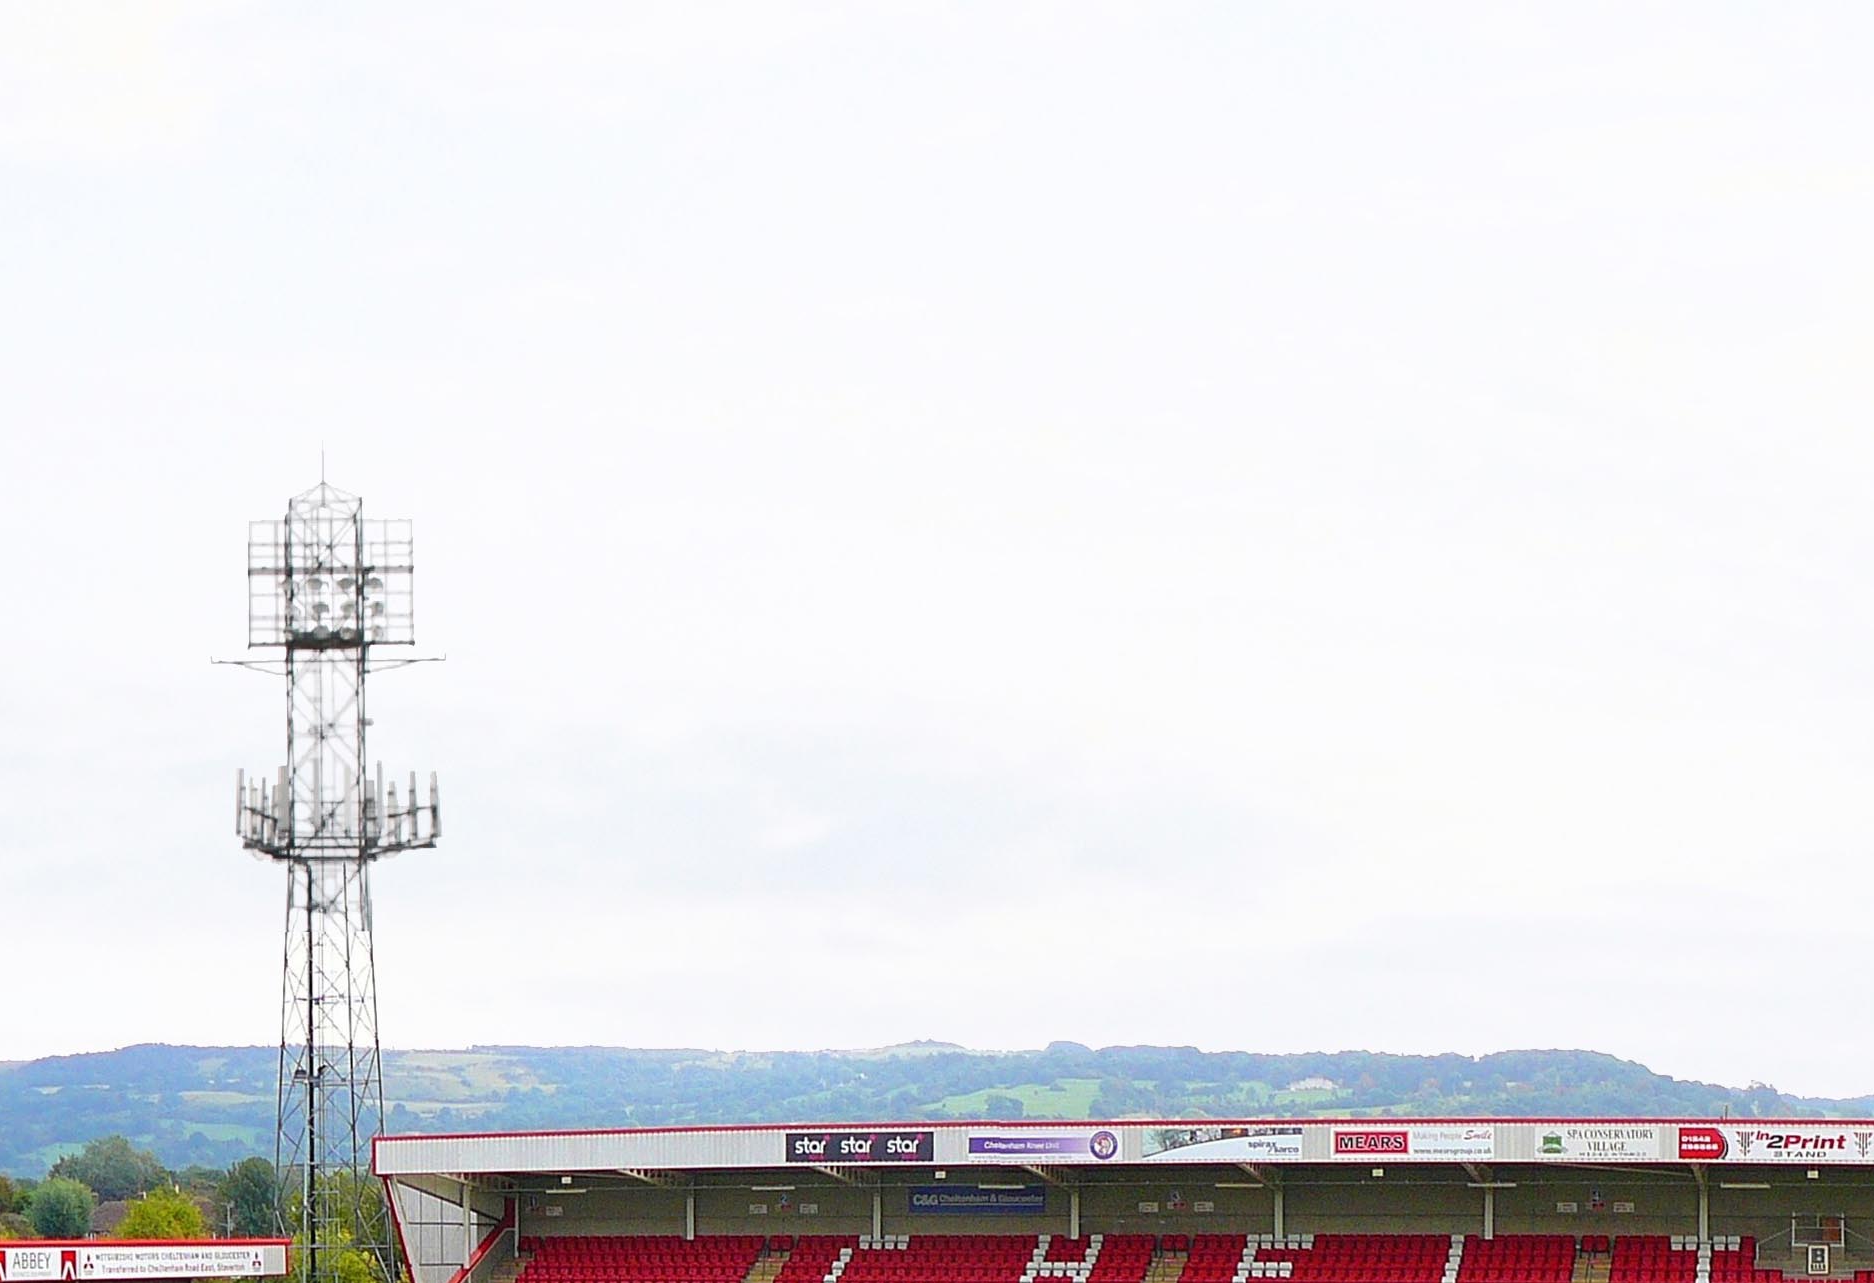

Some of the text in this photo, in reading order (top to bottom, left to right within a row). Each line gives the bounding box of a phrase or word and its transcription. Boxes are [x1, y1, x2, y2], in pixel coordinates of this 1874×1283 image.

[1464, 1129, 1492, 1140] Smile
[1567, 1129, 1654, 1139] SPA CONSERVATORY
[795, 1136, 826, 1154] star
[840, 1135, 871, 1153] star
[886, 1135, 919, 1153] star
[984, 1141, 1025, 1150] Cheltenham
[1248, 1140, 1276, 1149] spirax
[1339, 1136, 1403, 1149] MEARS
[1587, 1141, 1626, 1151] VILLAGE
[913, 1195, 938, 1206] C&G
[13, 1252, 51, 1269] ABBEY
[161, 1252, 199, 1260] CHELTENHAM
[214, 1251, 250, 1259] GLOUCESTER
[102, 1263, 138, 1273] Transferred
[140, 1264, 146, 1272] to
[185, 1263, 199, 1272] Road
